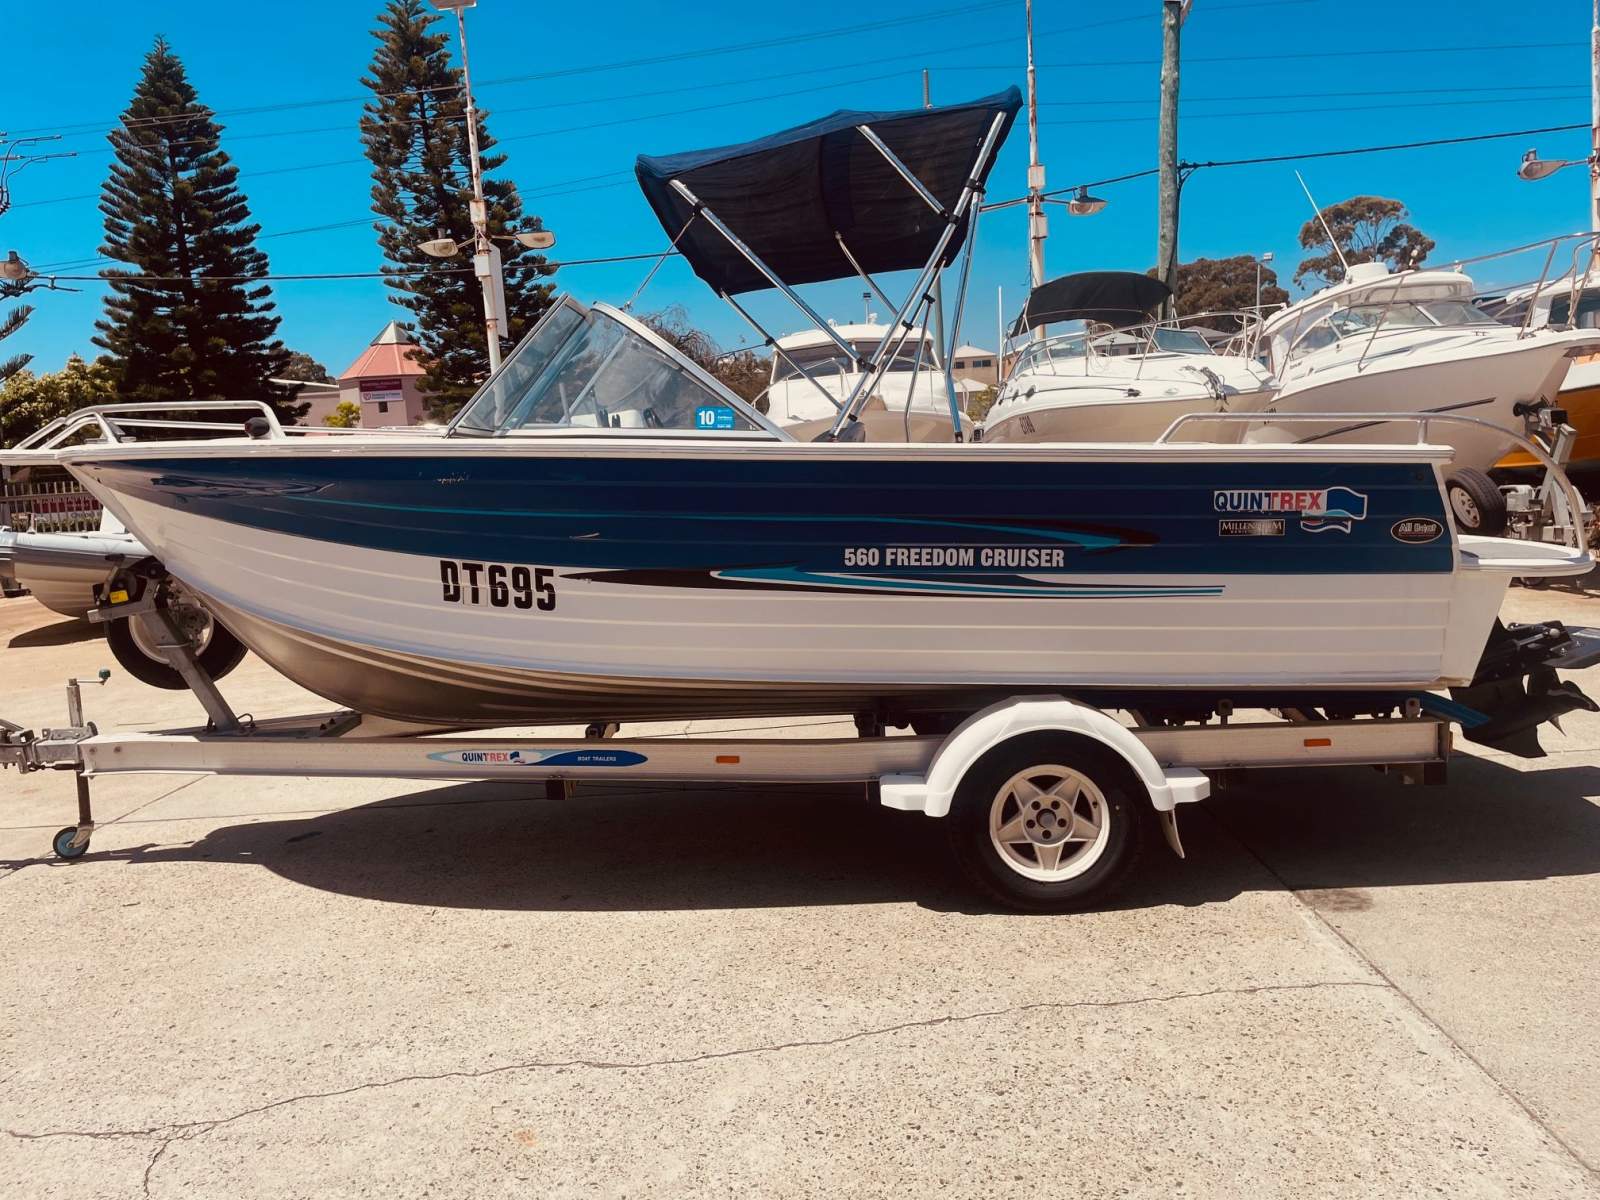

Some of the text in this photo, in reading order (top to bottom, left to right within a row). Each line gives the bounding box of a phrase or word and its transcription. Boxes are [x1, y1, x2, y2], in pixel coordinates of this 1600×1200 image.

[698, 410, 715, 426] 10
[1214, 491, 1322, 511] QUINTREX
[1221, 521, 1282, 531] MILLENNM
[844, 548, 1065, 568] 560 FREEDOM CRUISER
[440, 559, 556, 612] DT695
[461, 752, 508, 762] QUINTREX
